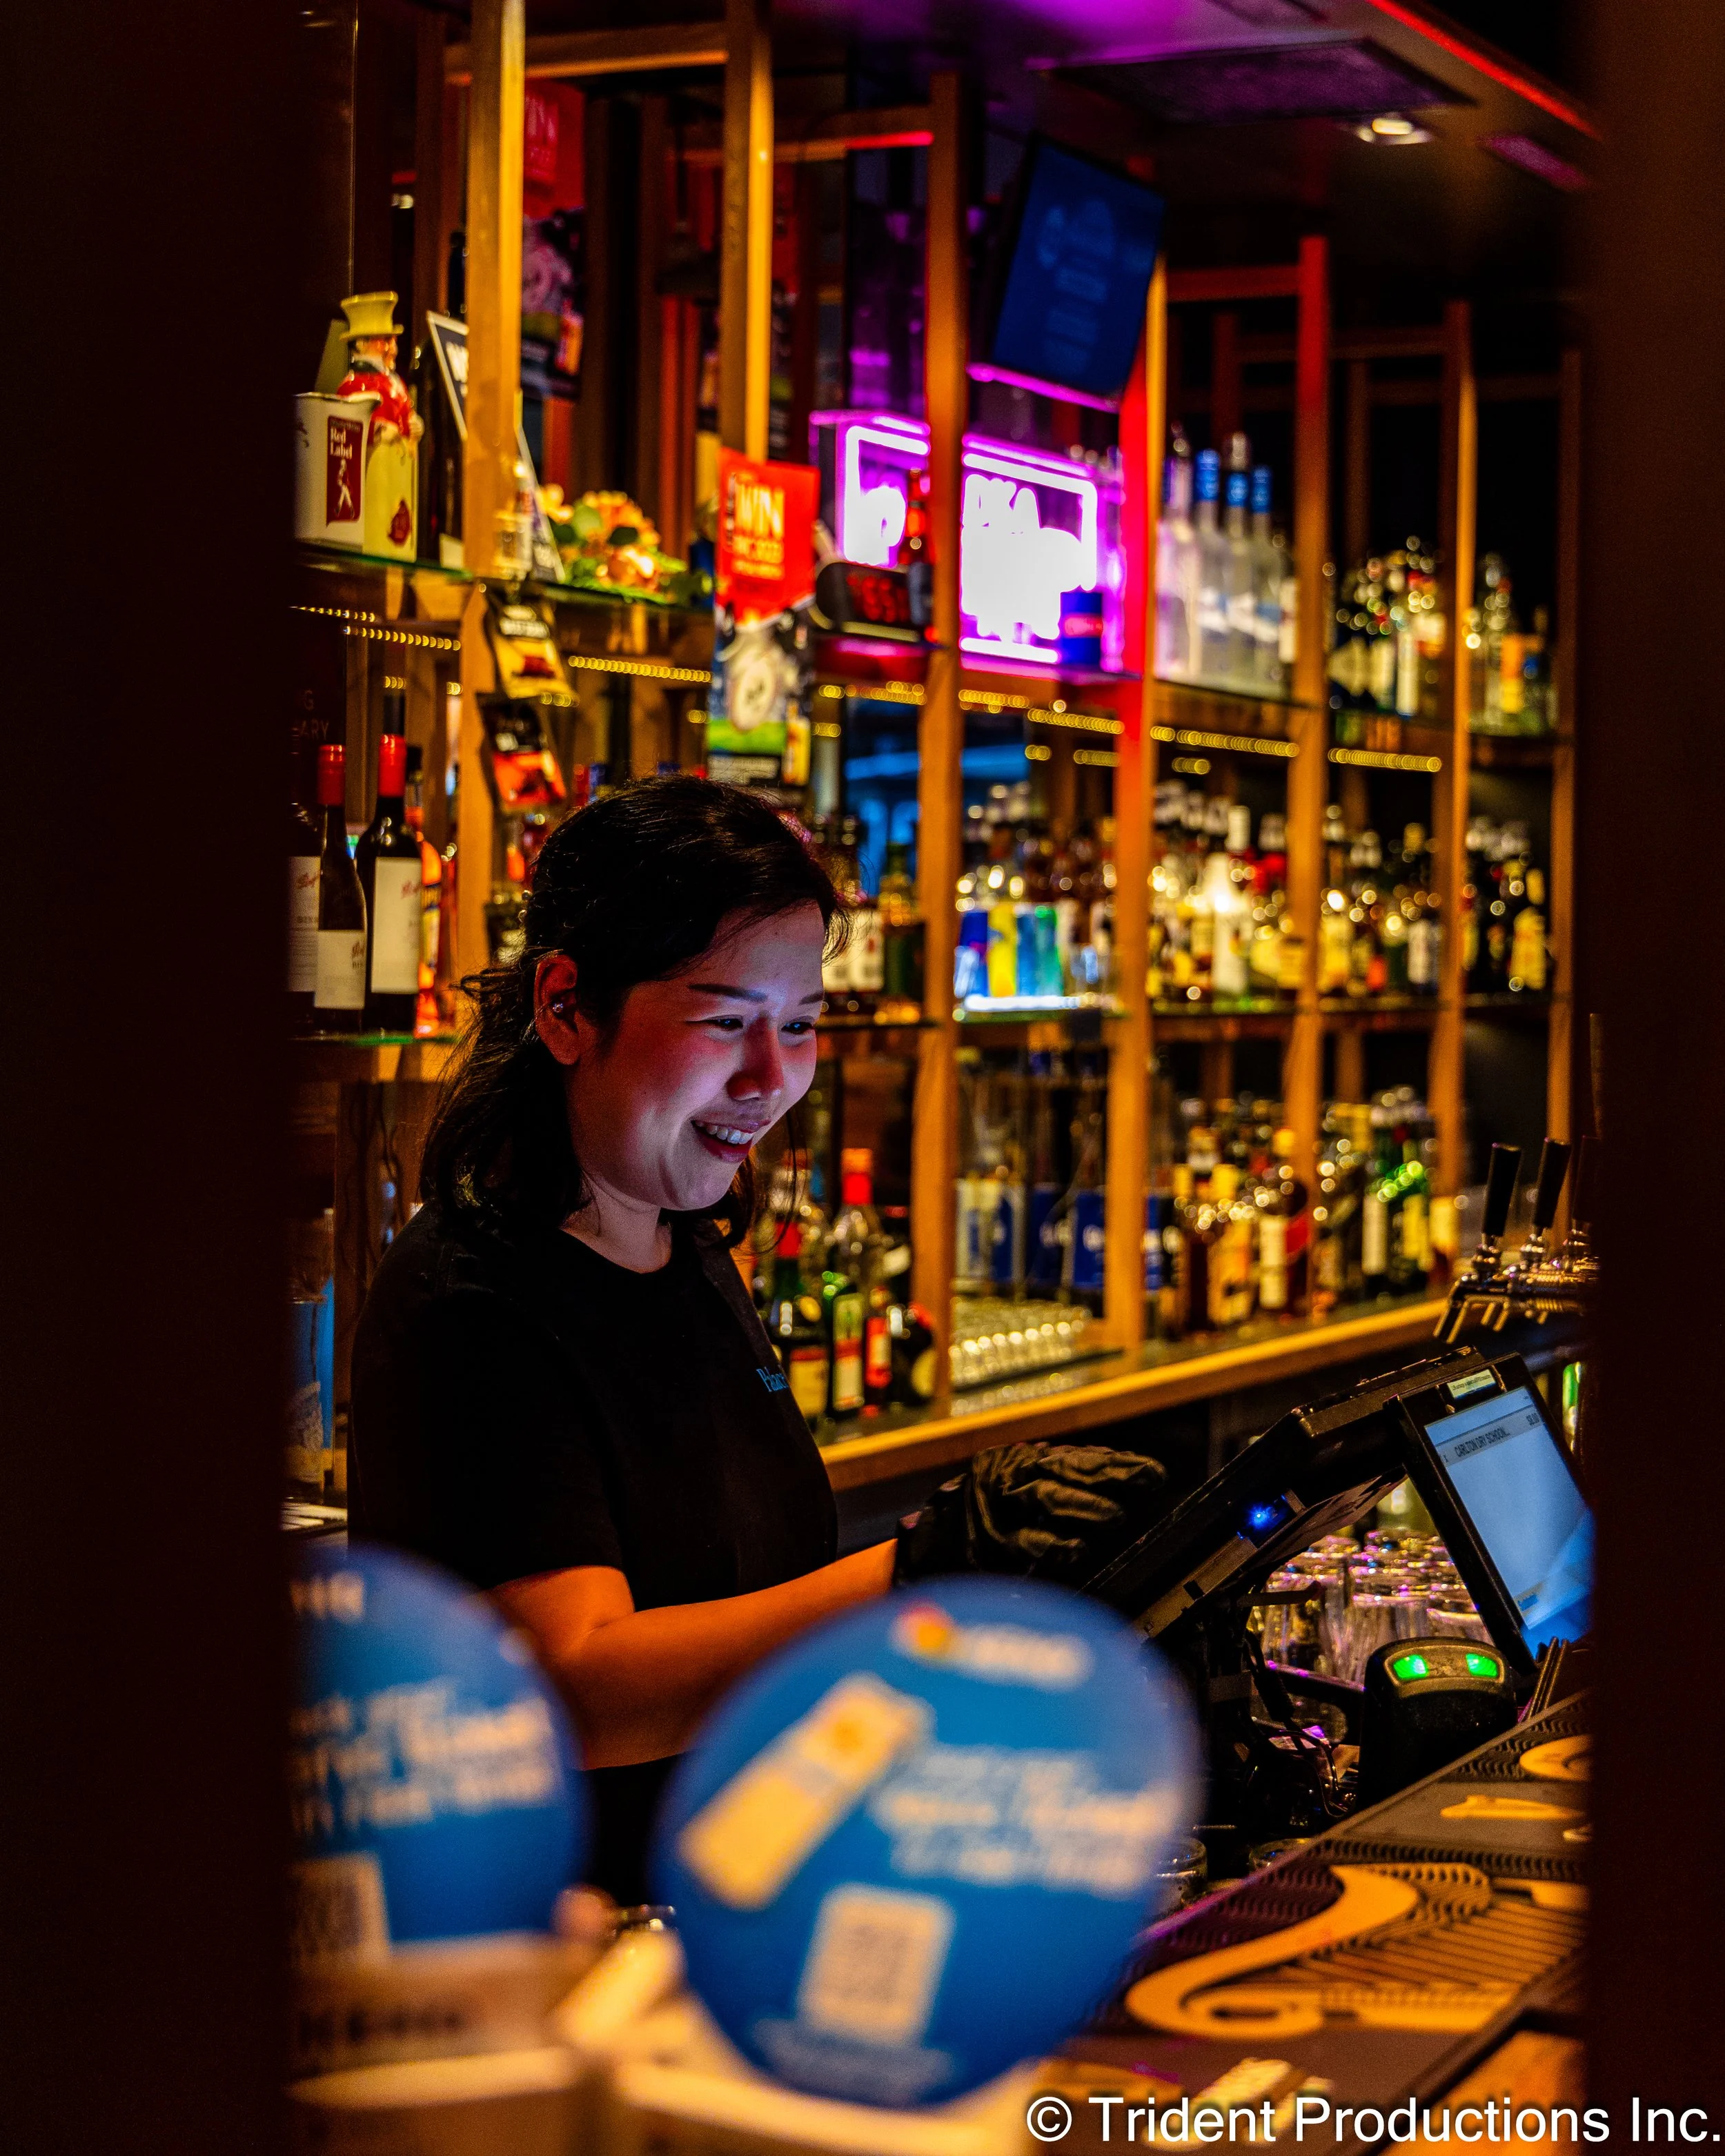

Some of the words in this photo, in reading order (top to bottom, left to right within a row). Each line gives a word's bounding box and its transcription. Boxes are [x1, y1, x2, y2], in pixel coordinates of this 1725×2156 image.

[331, 427, 346, 444] Red
[330, 441, 353, 459] Label
[735, 484, 784, 540] WIN
[1454, 1438, 1479, 1458] CARLTON
[1475, 1435, 1487, 1448] DRY
